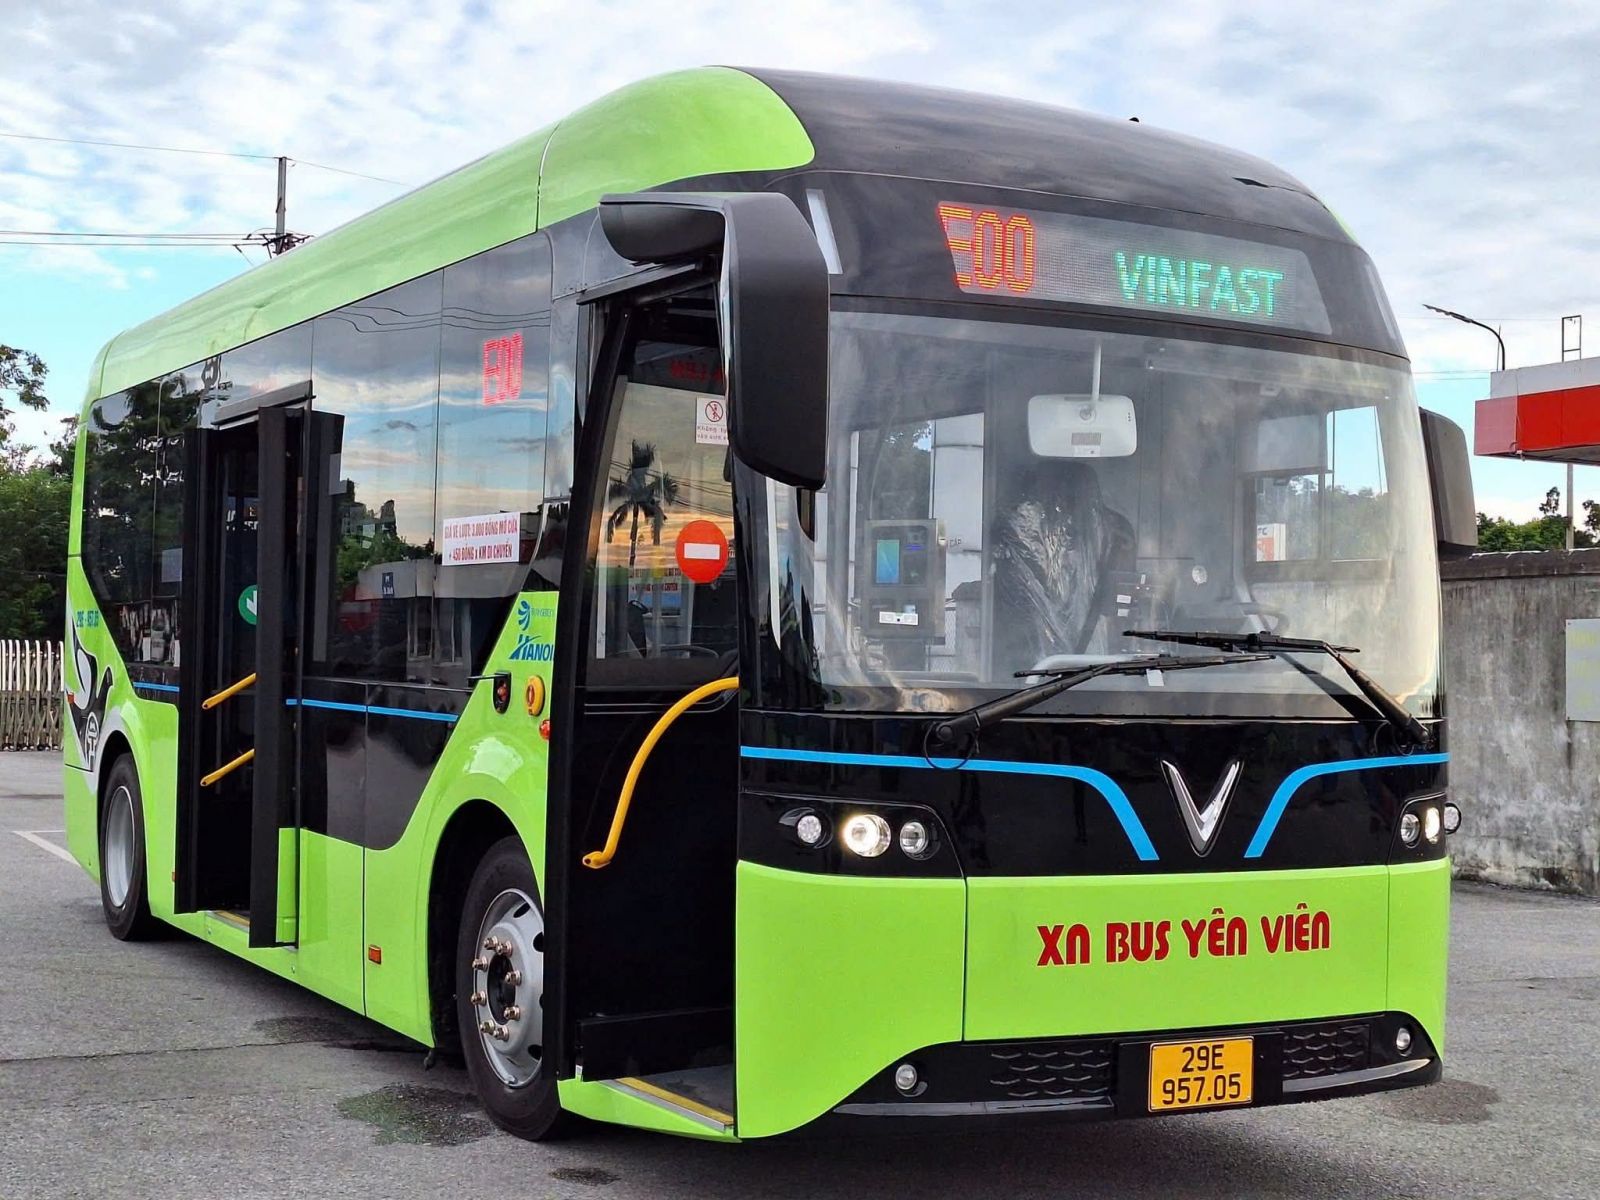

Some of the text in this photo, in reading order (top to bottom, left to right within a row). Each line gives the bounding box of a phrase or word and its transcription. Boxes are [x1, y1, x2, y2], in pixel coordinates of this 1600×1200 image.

[1114, 252, 1283, 317] VINFAST
[1106, 921, 1171, 963] BUS
[1181, 1044, 1224, 1073] 29E
[1162, 1073, 1242, 1105] 957.05
